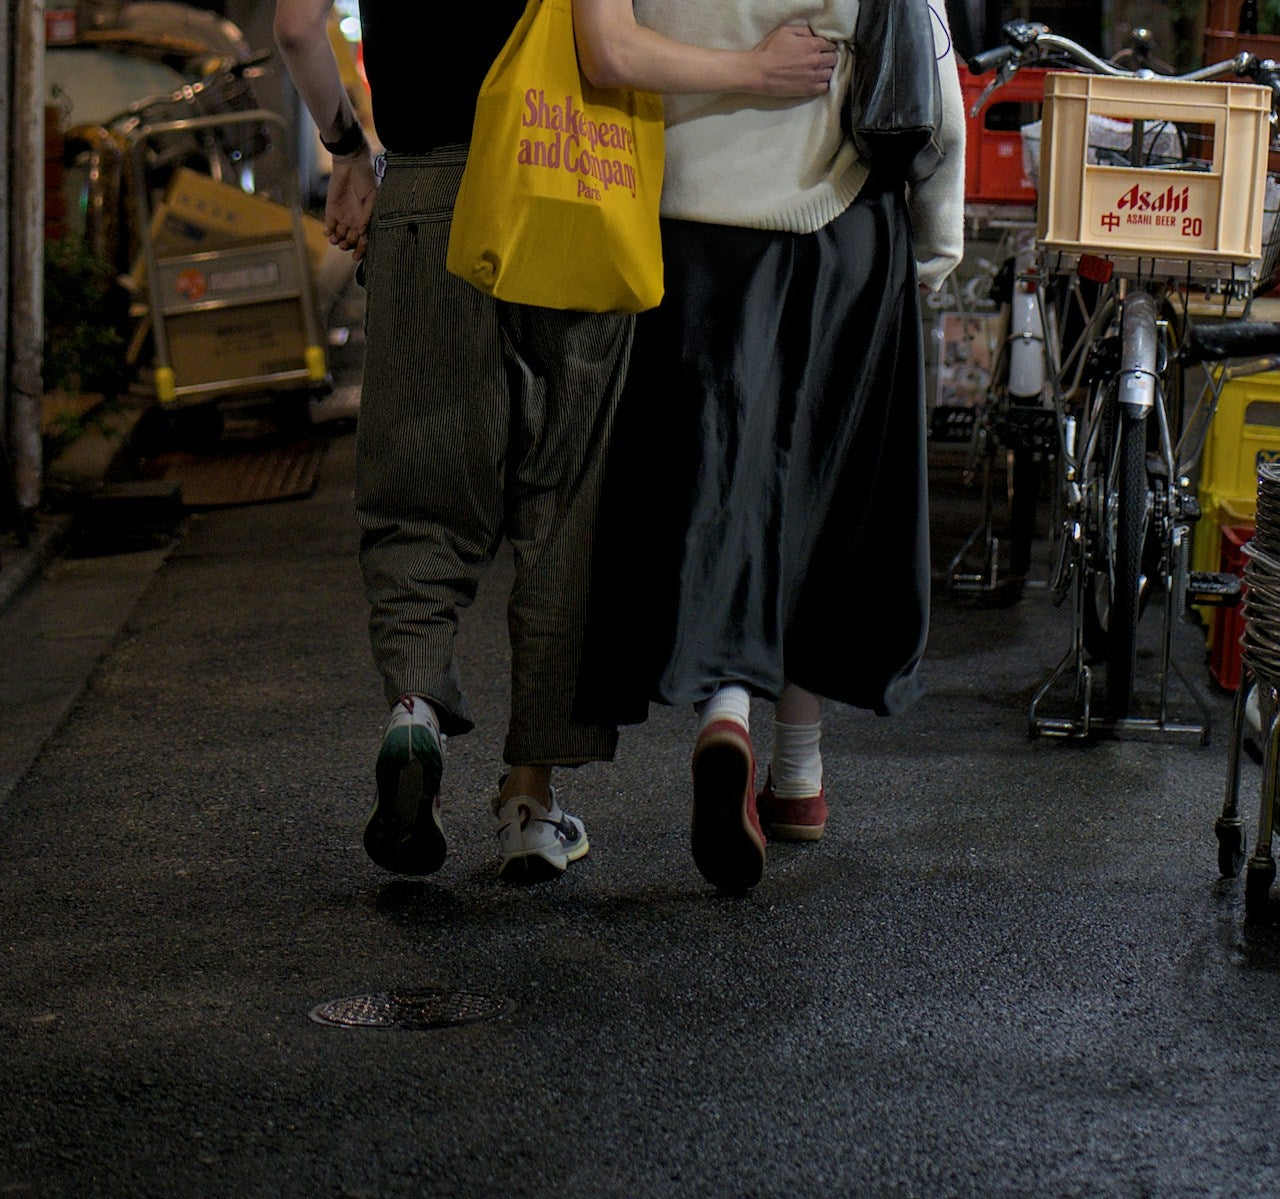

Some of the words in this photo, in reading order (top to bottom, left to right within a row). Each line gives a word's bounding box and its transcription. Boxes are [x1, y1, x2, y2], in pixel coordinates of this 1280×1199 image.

[517, 132, 561, 170] and
[1117, 184, 1191, 214] Asahi
[1101, 212, 1120, 233] 中
[1126, 213, 1153, 227] ASAHI
[1155, 214, 1177, 228] BEER
[1182, 217, 1203, 238] 20
